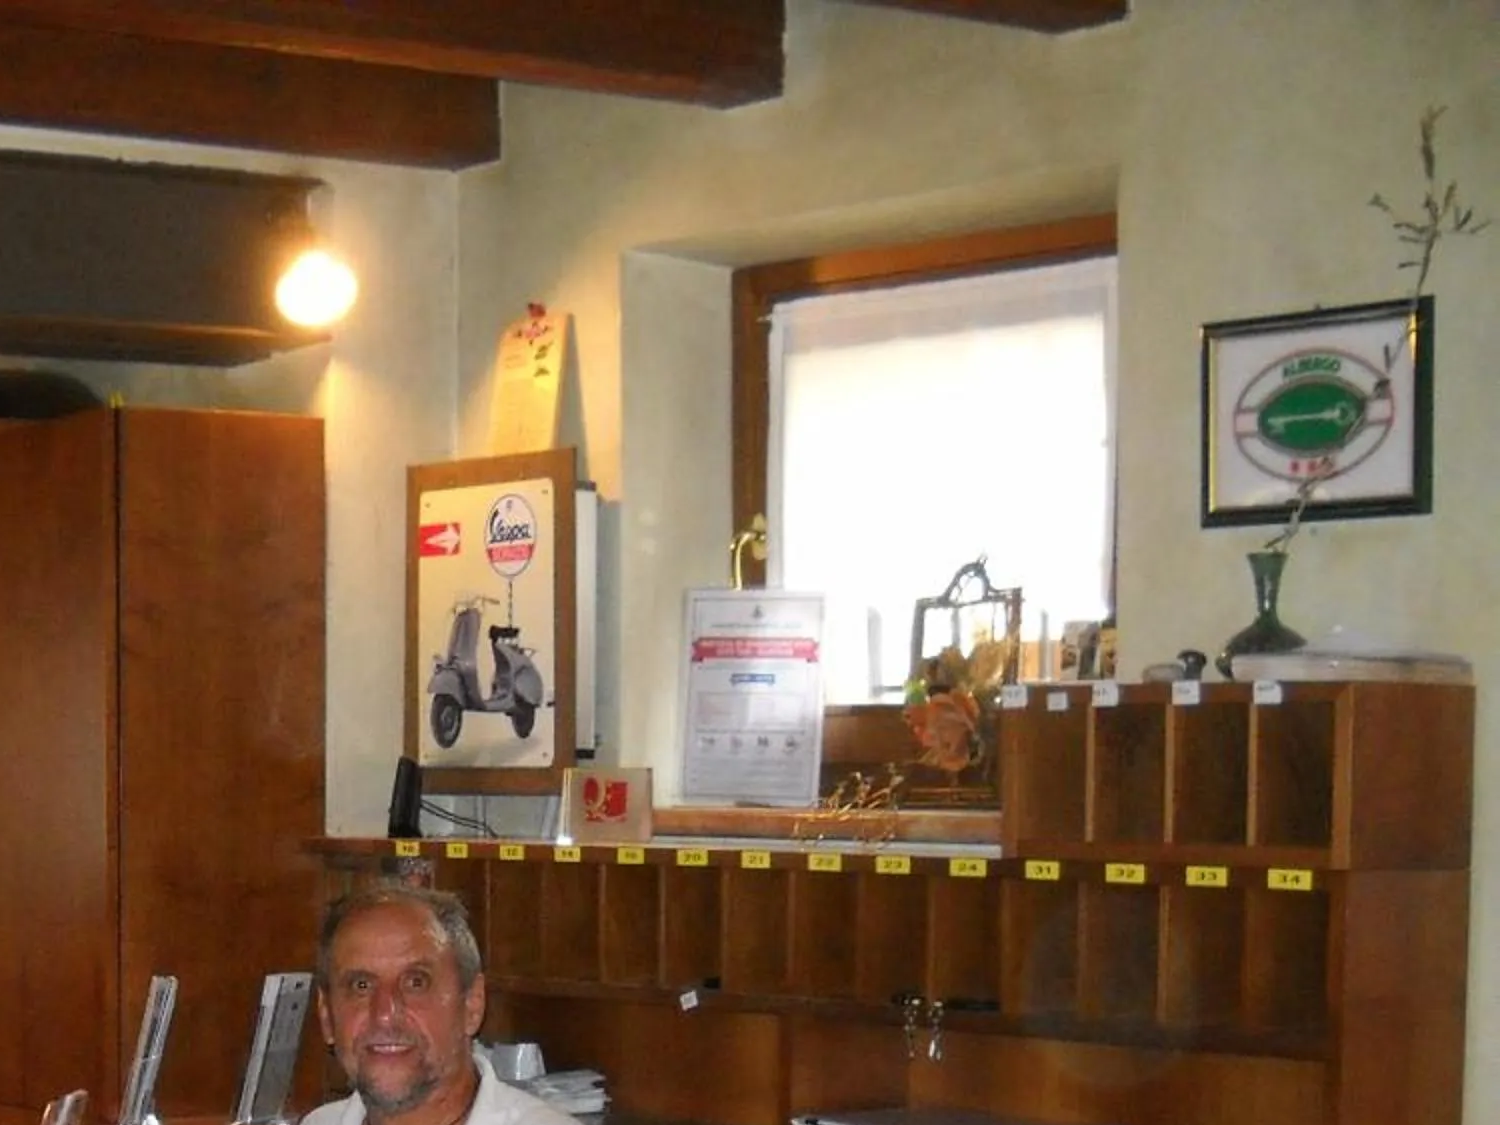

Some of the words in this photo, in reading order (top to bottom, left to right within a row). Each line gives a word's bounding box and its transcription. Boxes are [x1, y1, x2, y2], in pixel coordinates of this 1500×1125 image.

[488, 507, 533, 544] Vespa
[747, 854, 766, 865] 21
[957, 861, 978, 873] 24
[1033, 864, 1052, 876] 31
[1114, 867, 1136, 879] 32
[1198, 870, 1218, 882] 33
[1278, 874, 1301, 887] 34
